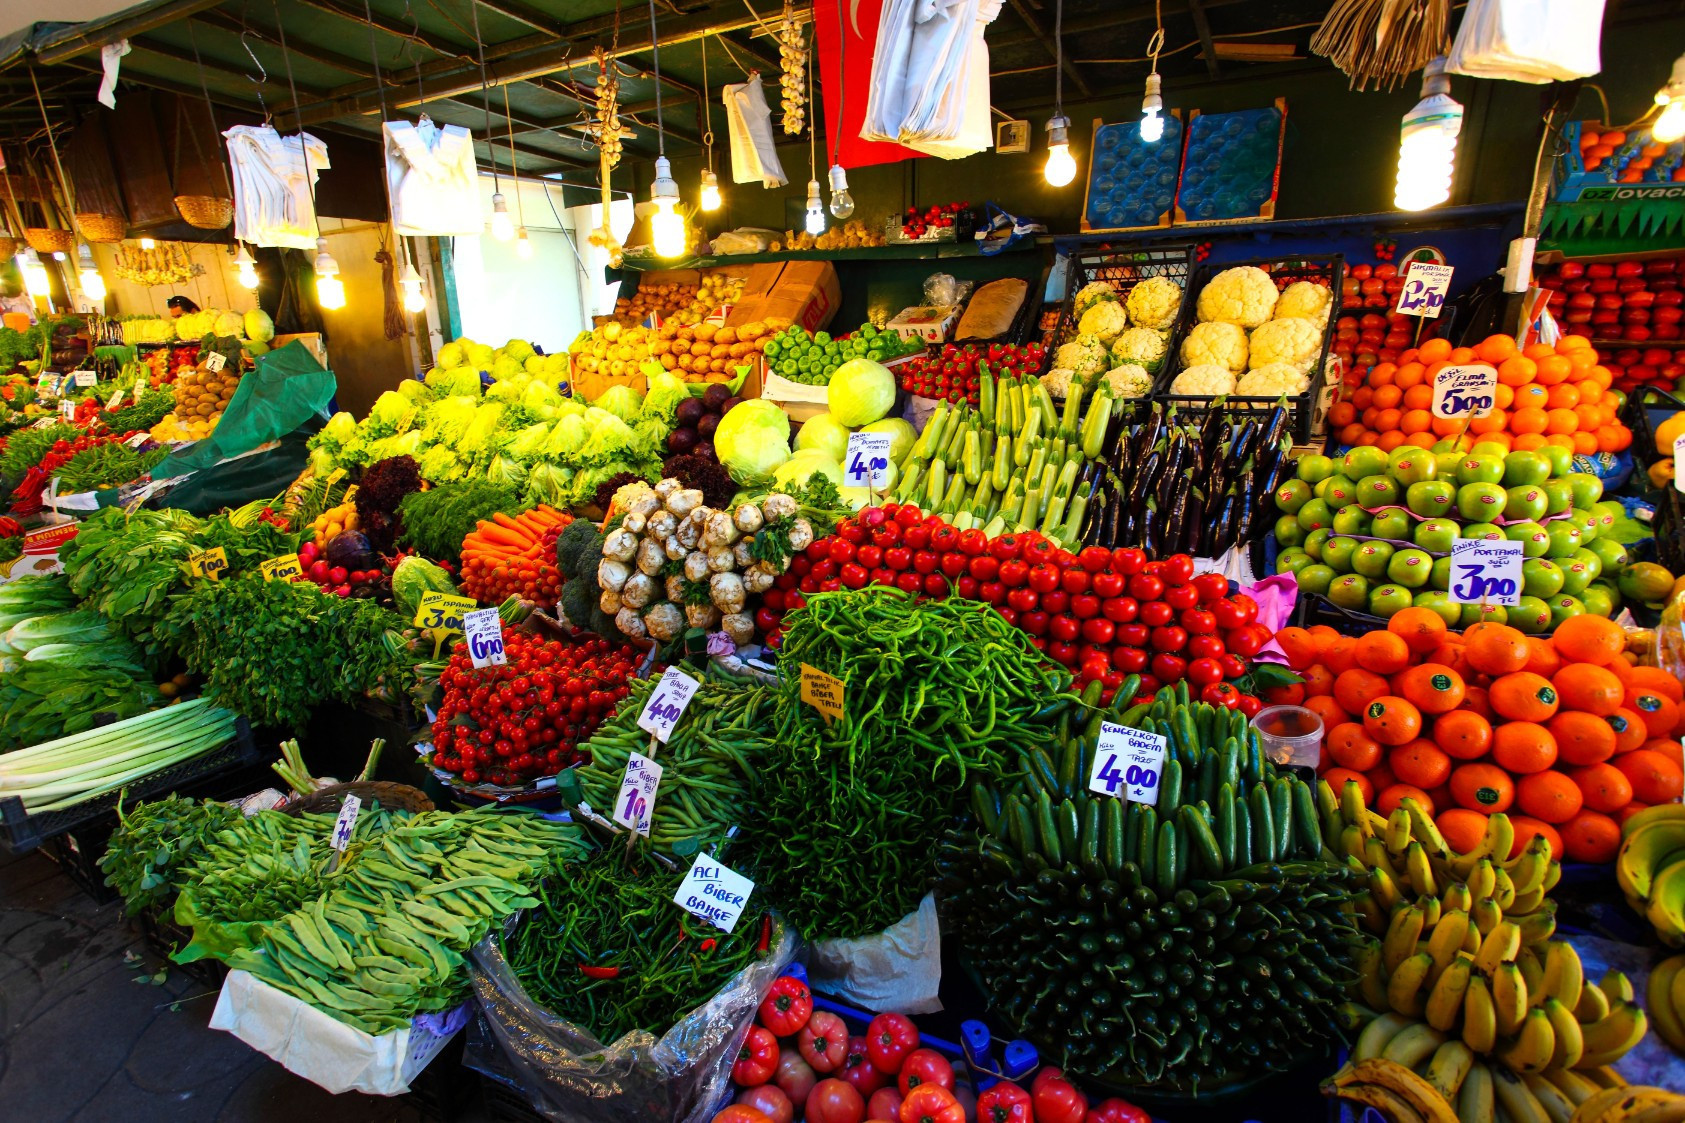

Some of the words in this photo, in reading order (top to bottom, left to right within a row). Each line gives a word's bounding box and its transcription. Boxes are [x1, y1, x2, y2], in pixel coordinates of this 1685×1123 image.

[1128, 737, 1162, 752] BADEM
[628, 759, 644, 769] ACI
[623, 788, 647, 821] 10
[692, 866, 720, 879] ACI
